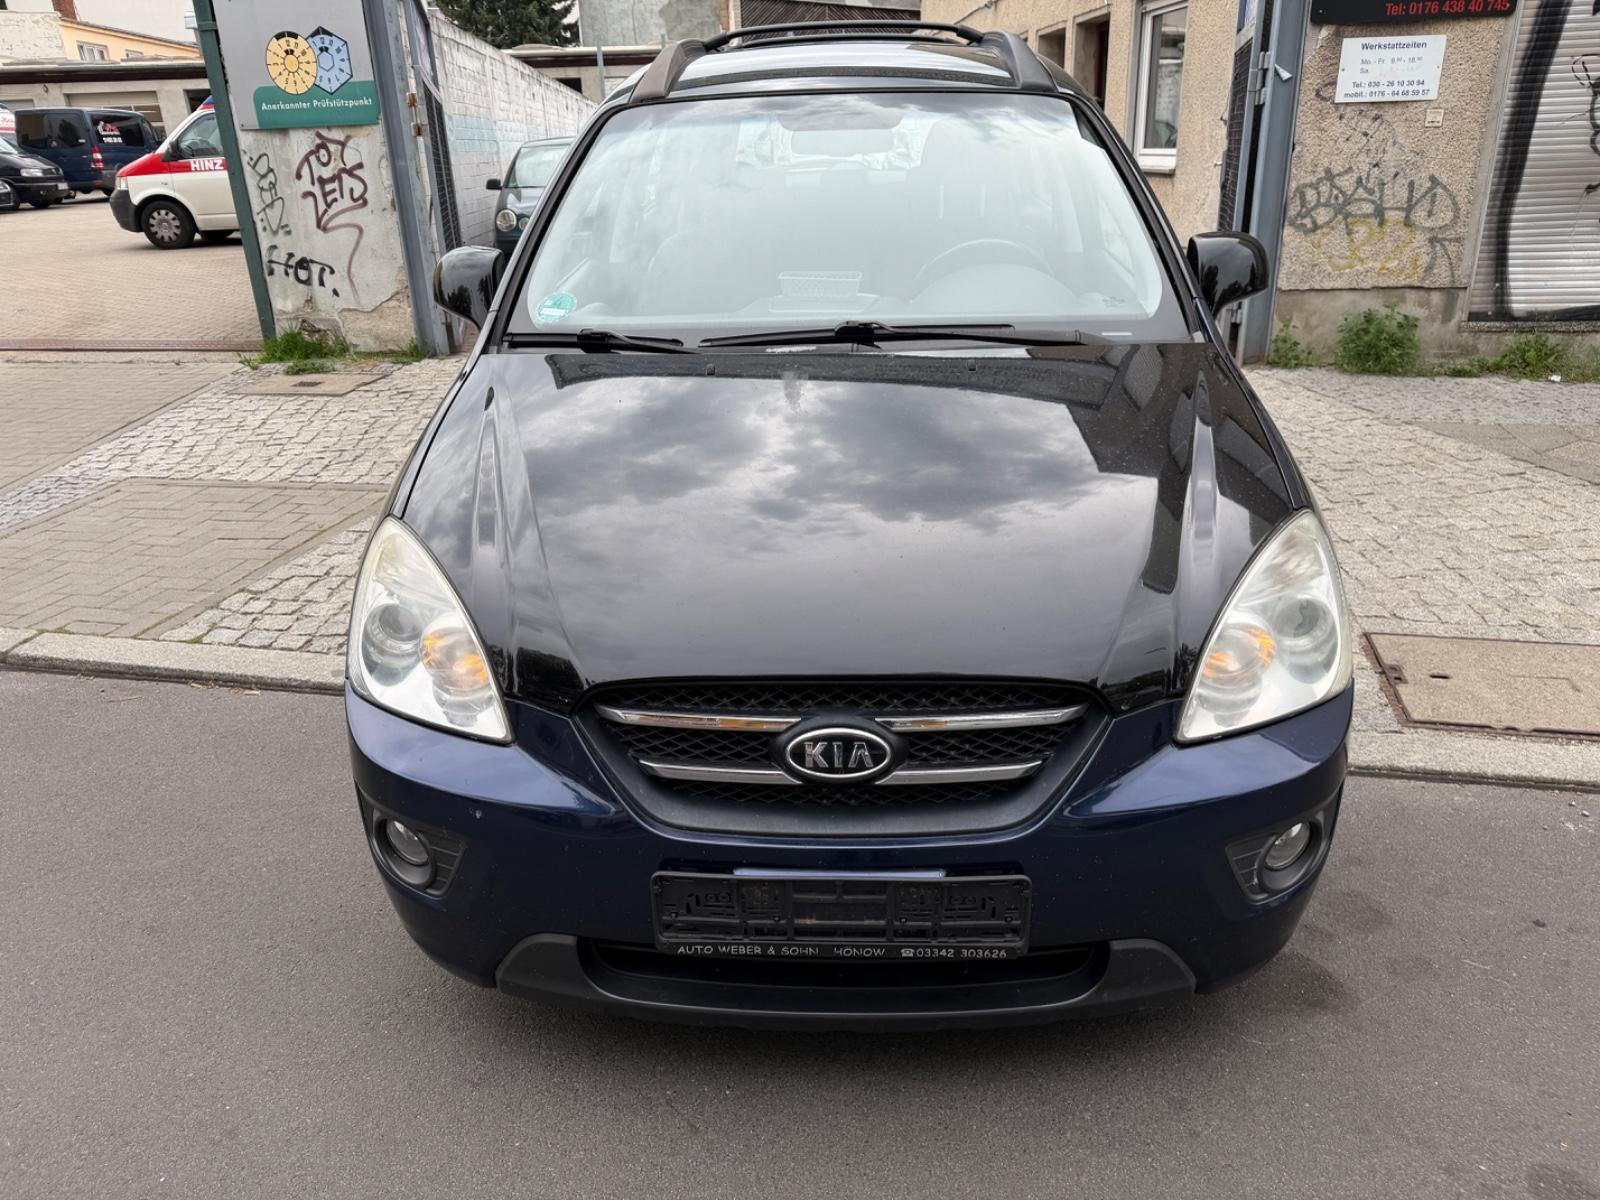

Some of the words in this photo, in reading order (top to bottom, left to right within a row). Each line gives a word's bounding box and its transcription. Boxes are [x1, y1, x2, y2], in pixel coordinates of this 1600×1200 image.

[1386, 3, 1406, 16] Tel:
[1409, 1, 1439, 15] 0176
[1442, 0, 1465, 13] 438
[1468, 0, 1483, 12] 40
[1361, 41, 1427, 50] Werkstattzeiten
[261, 100, 311, 111] Anerkannter
[313, 97, 372, 108] Prüfstützpunkt
[190, 159, 224, 171] HINZ
[803, 741, 874, 768] KIA
[677, 945, 714, 955] AUTO
[718, 945, 762, 955] WEBER
[767, 946, 776, 956] &
[781, 946, 819, 956] SOHN
[960, 949, 1007, 959] 303626
